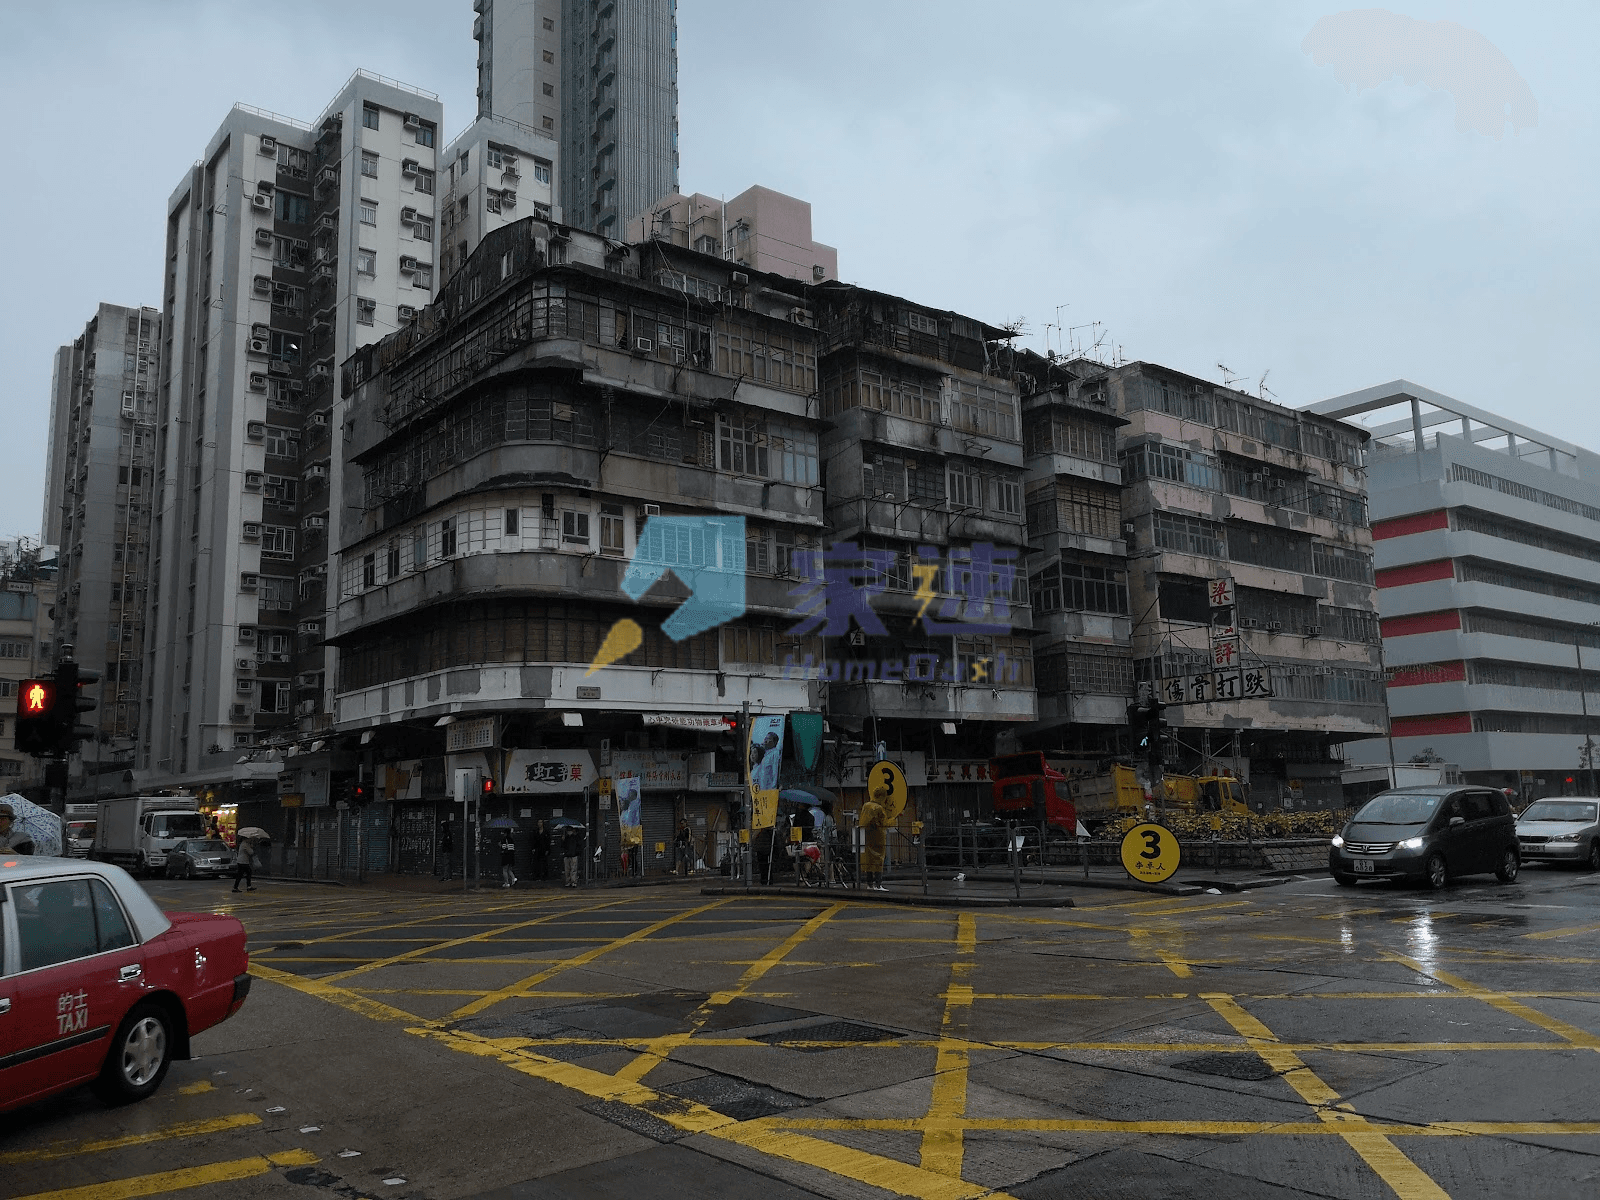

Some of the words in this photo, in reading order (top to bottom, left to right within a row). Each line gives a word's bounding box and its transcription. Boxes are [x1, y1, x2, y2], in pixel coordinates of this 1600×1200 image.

[881, 768, 894, 795] 3
[1140, 830, 1160, 859] 3
[58, 988, 88, 1012] 的士
[57, 1008, 88, 1034] TAXI
